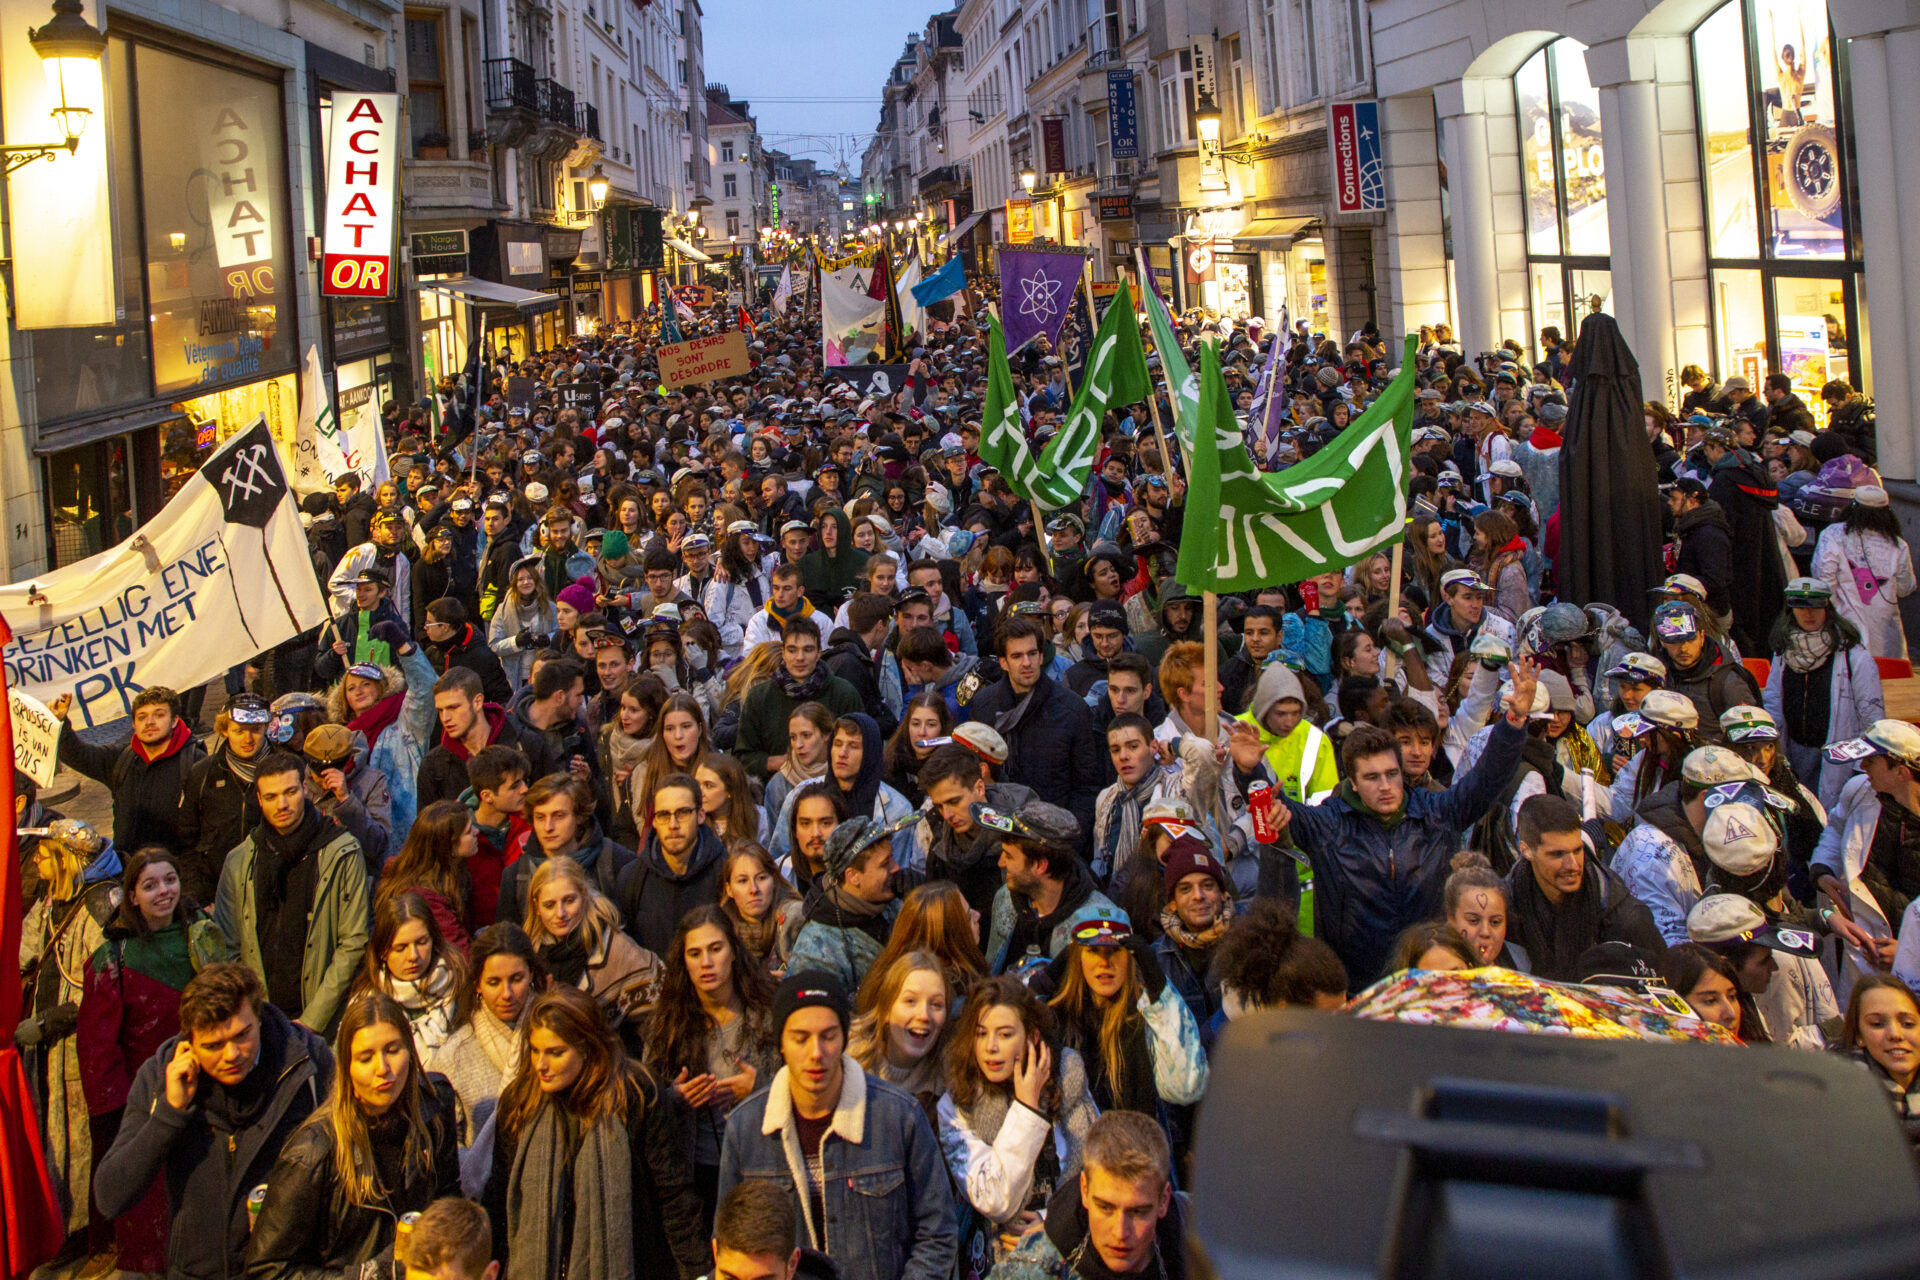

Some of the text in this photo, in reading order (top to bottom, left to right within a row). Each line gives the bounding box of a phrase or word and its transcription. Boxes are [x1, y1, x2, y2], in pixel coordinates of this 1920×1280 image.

[1109, 83, 1119, 136] MONTRES
[1126, 82, 1135, 135] BIJOUX
[1117, 138, 1133, 147] OR
[342, 99, 384, 248] ACHAT
[1338, 115, 1356, 204] Connections
[1101, 196, 1129, 207] ACHAT
[430, 235, 457, 244] Nargui
[430, 243, 458, 251] House
[331, 259, 385, 290] OR
[658, 345, 680, 359] NOS
[676, 352, 704, 367] SONT
[202, 362, 217, 383] de
[669, 358, 731, 382] DESORDRE
[161, 539, 226, 599] ENE
[136, 591, 197, 648] MET
[75, 661, 148, 728] PK
[13, 697, 54, 738] BRUSSEL
[14, 743, 41, 775] ONS
[32, 738, 49, 758] VAN
[1255, 805, 1266, 836] Jupiler
